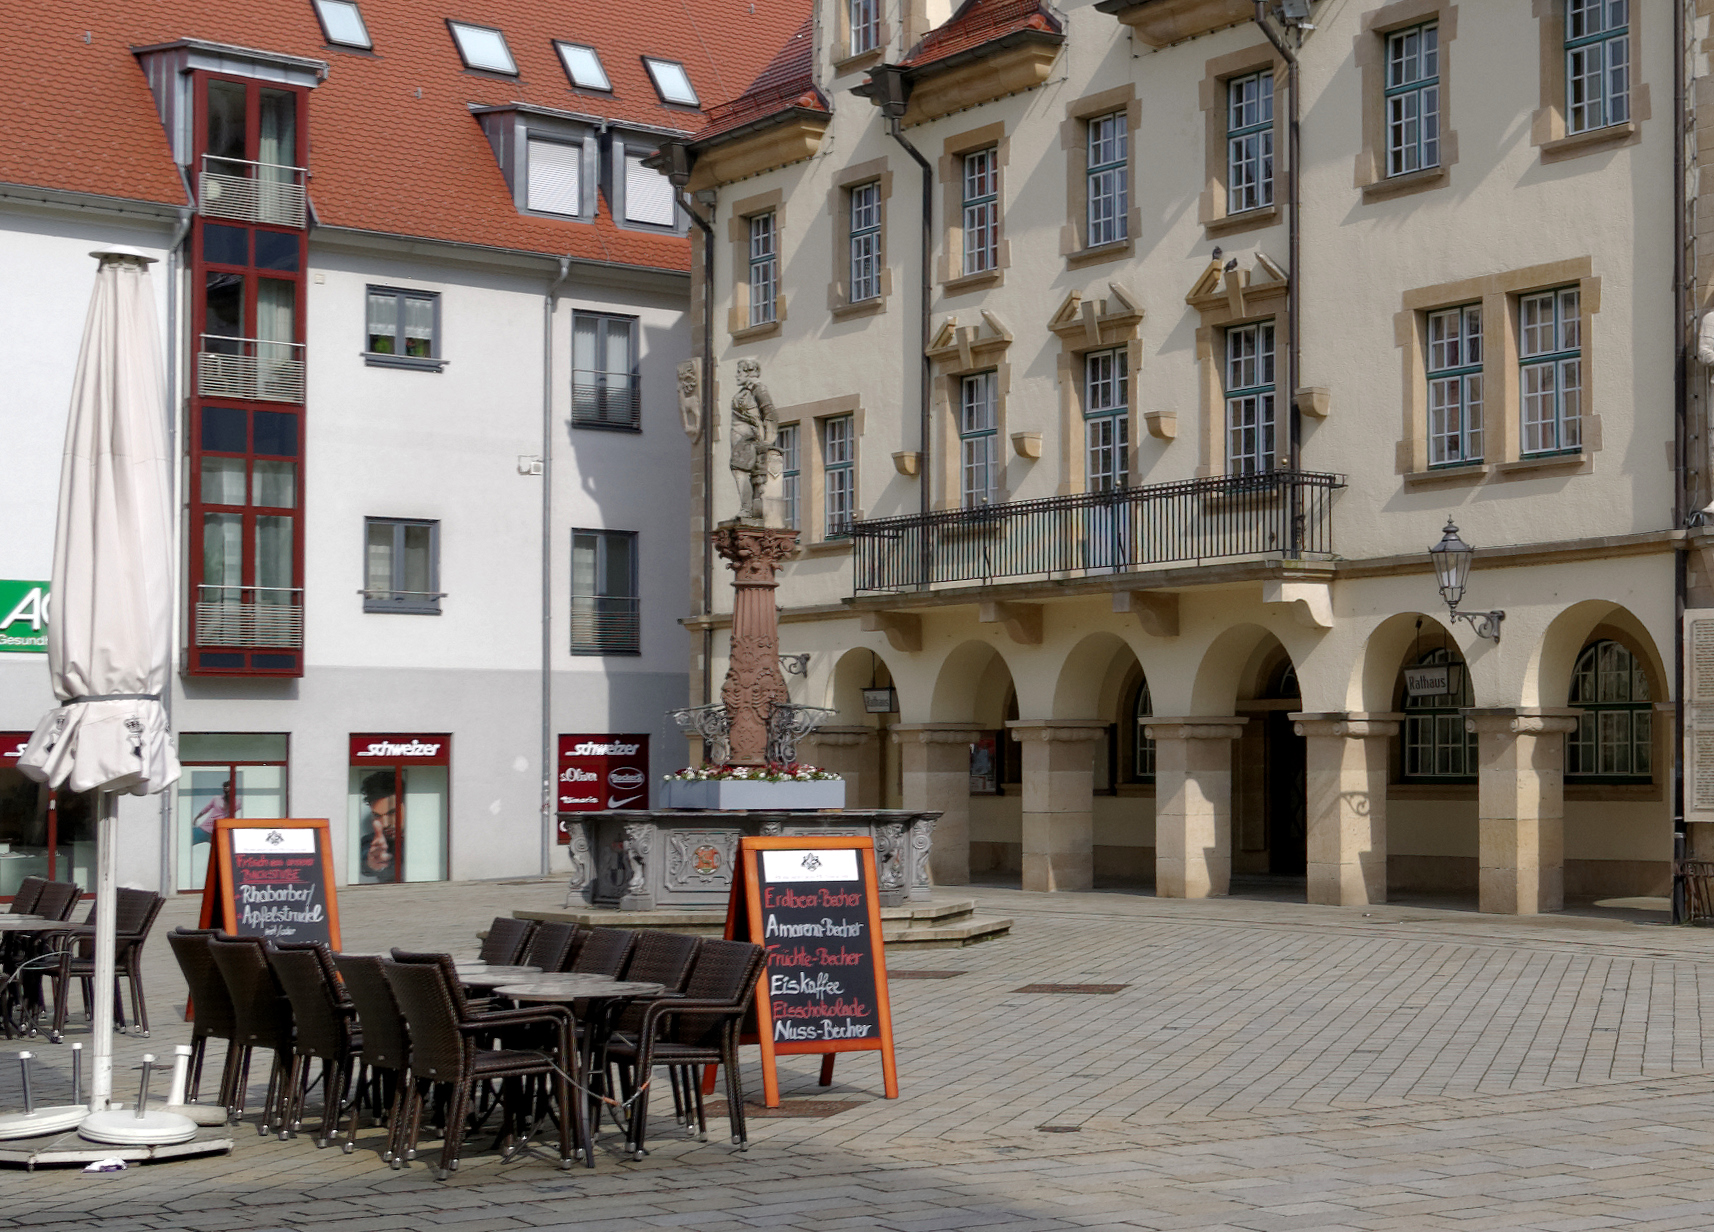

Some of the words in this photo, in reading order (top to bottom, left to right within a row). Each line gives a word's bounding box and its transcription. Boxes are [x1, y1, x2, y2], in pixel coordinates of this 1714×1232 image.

[1408, 675, 1447, 691] Rathaus
[356, 739, 441, 757] schweizer
[564, 740, 640, 757] schweizer
[770, 971, 845, 1000] Eiskaffee
[772, 996, 872, 1020] Eisschokolade
[774, 1017, 872, 1042] Nuss-Becher
